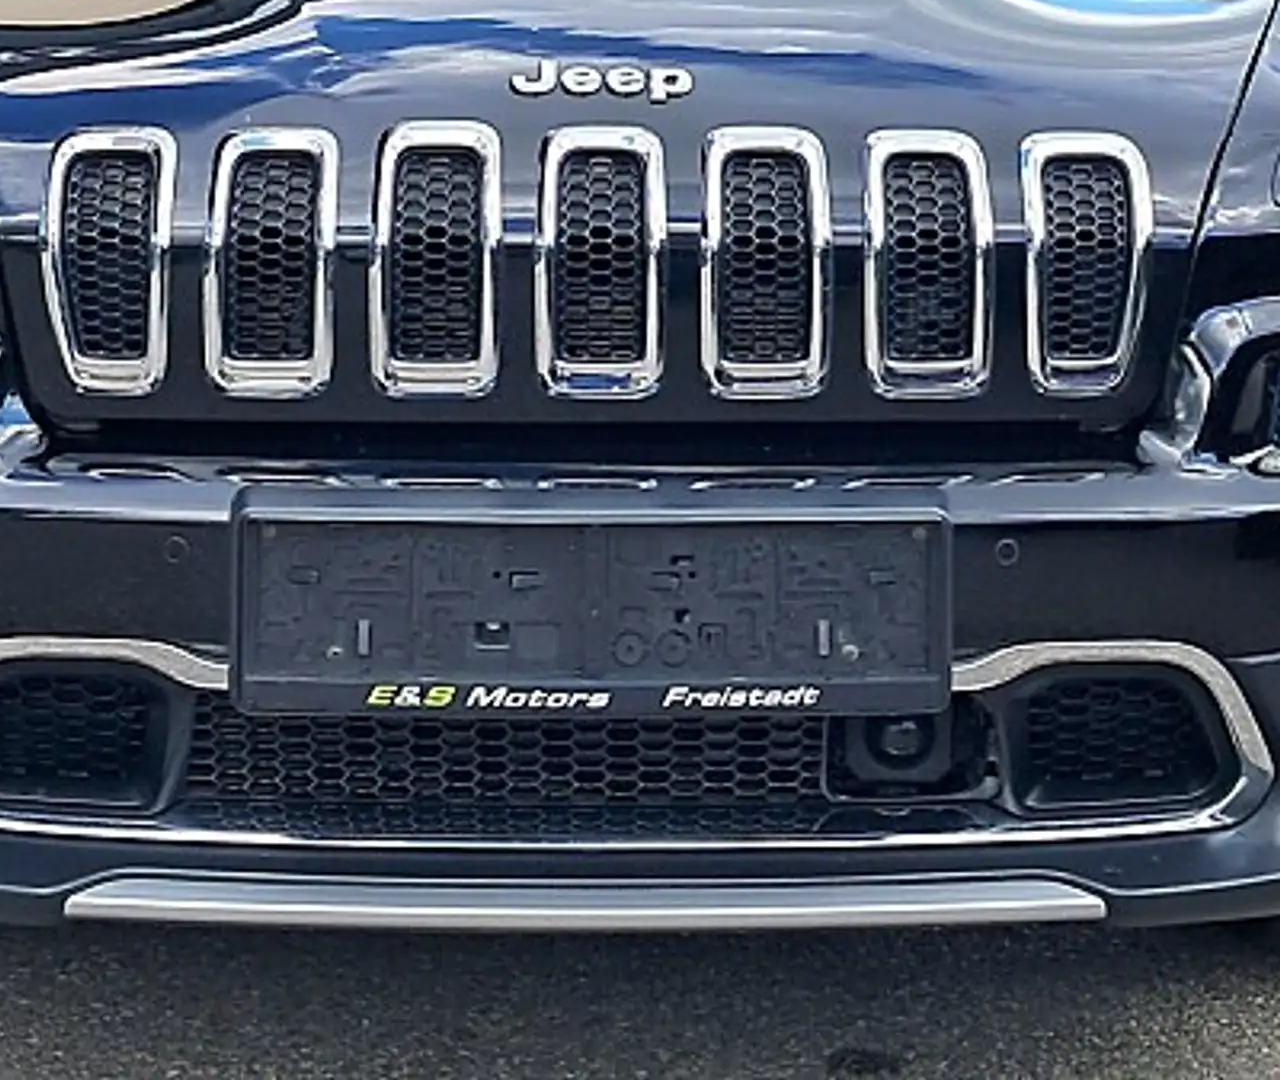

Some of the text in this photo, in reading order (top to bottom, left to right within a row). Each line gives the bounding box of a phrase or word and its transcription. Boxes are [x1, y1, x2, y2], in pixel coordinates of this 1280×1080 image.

[511, 59, 694, 104] Jeep
[366, 685, 821, 708] E&S Motors Freistadt
